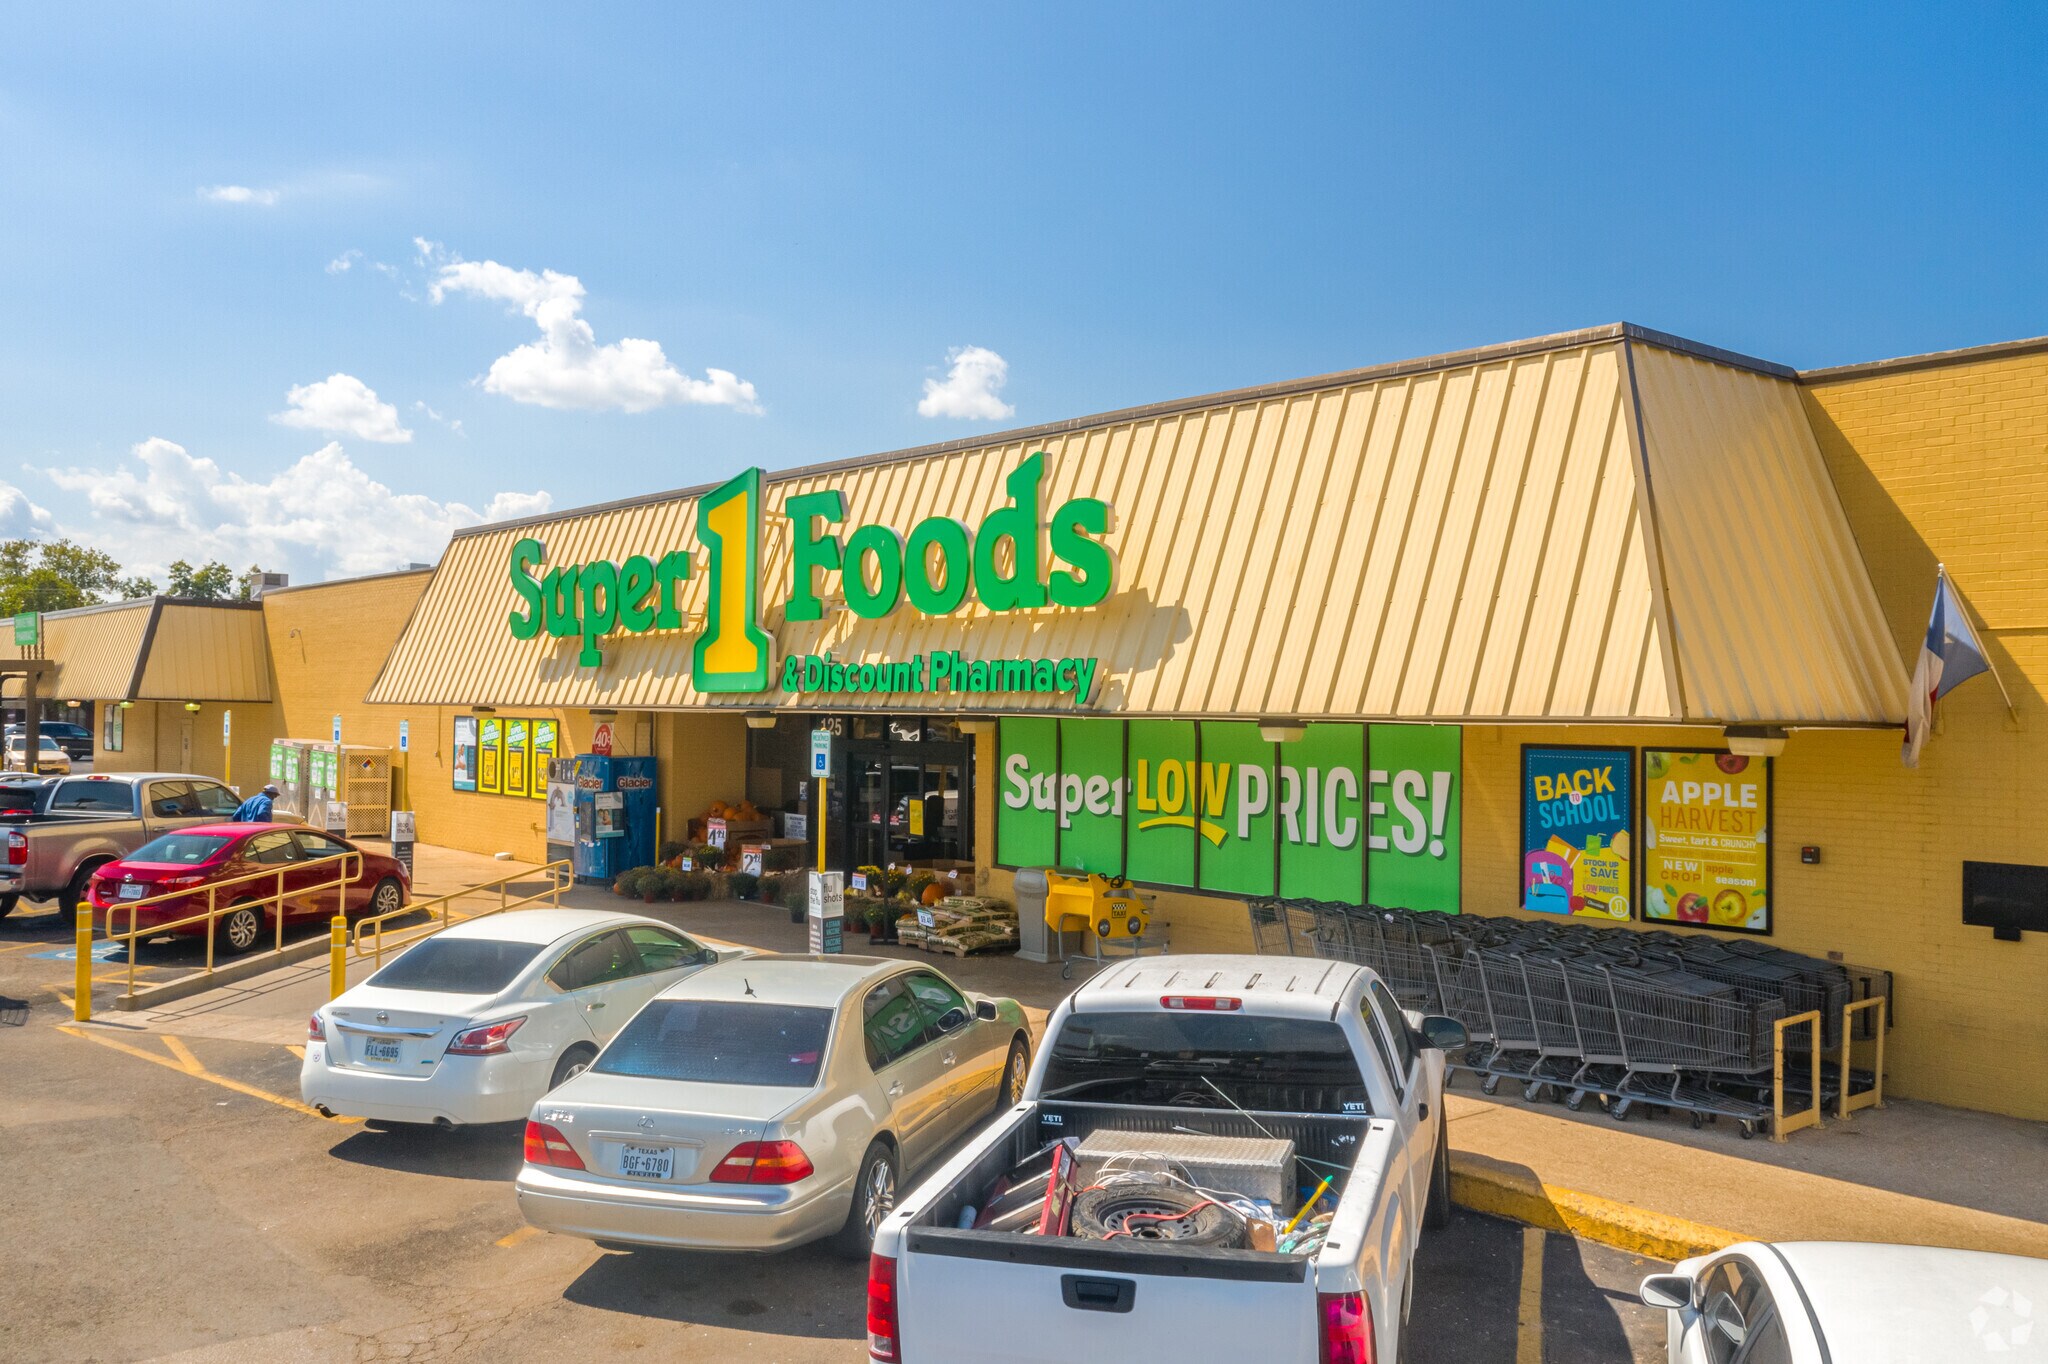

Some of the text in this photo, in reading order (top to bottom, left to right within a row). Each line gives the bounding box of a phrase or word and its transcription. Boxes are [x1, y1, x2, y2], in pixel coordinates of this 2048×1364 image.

[509, 451, 1116, 693] Super 1 Foods
[782, 650, 1098, 704] & Discount Pharmacy
[821, 718, 842, 736] 125
[578, 776, 603, 789] Glacier
[617, 777, 652, 788] Glacier
[1534, 766, 1616, 801] BACK
[1571, 793, 1580, 802] TO
[1661, 781, 1757, 808] APPLE
[1003, 753, 1452, 858] Super LOW PRICES!
[1539, 794, 1620, 828] SCHOOL
[1660, 806, 1757, 833] HARVEST
[1659, 834, 1757, 849] Sweet, tart & CRUNCHY
[1583, 859, 1607, 867] STOCK
[1664, 860, 1698, 871] NEW
[1590, 867, 1619, 879] SAVE
[1705, 865, 1733, 874] apple
[1661, 871, 1701, 882] CROP
[1715, 877, 1757, 887] season!
[823, 883, 833, 893] flu
[1599, 885, 1619, 894] PRICES
[823, 894, 843, 904] shots
[1343, 1102, 1365, 1110] YETI
[1042, 1114, 1062, 1122] YETI
